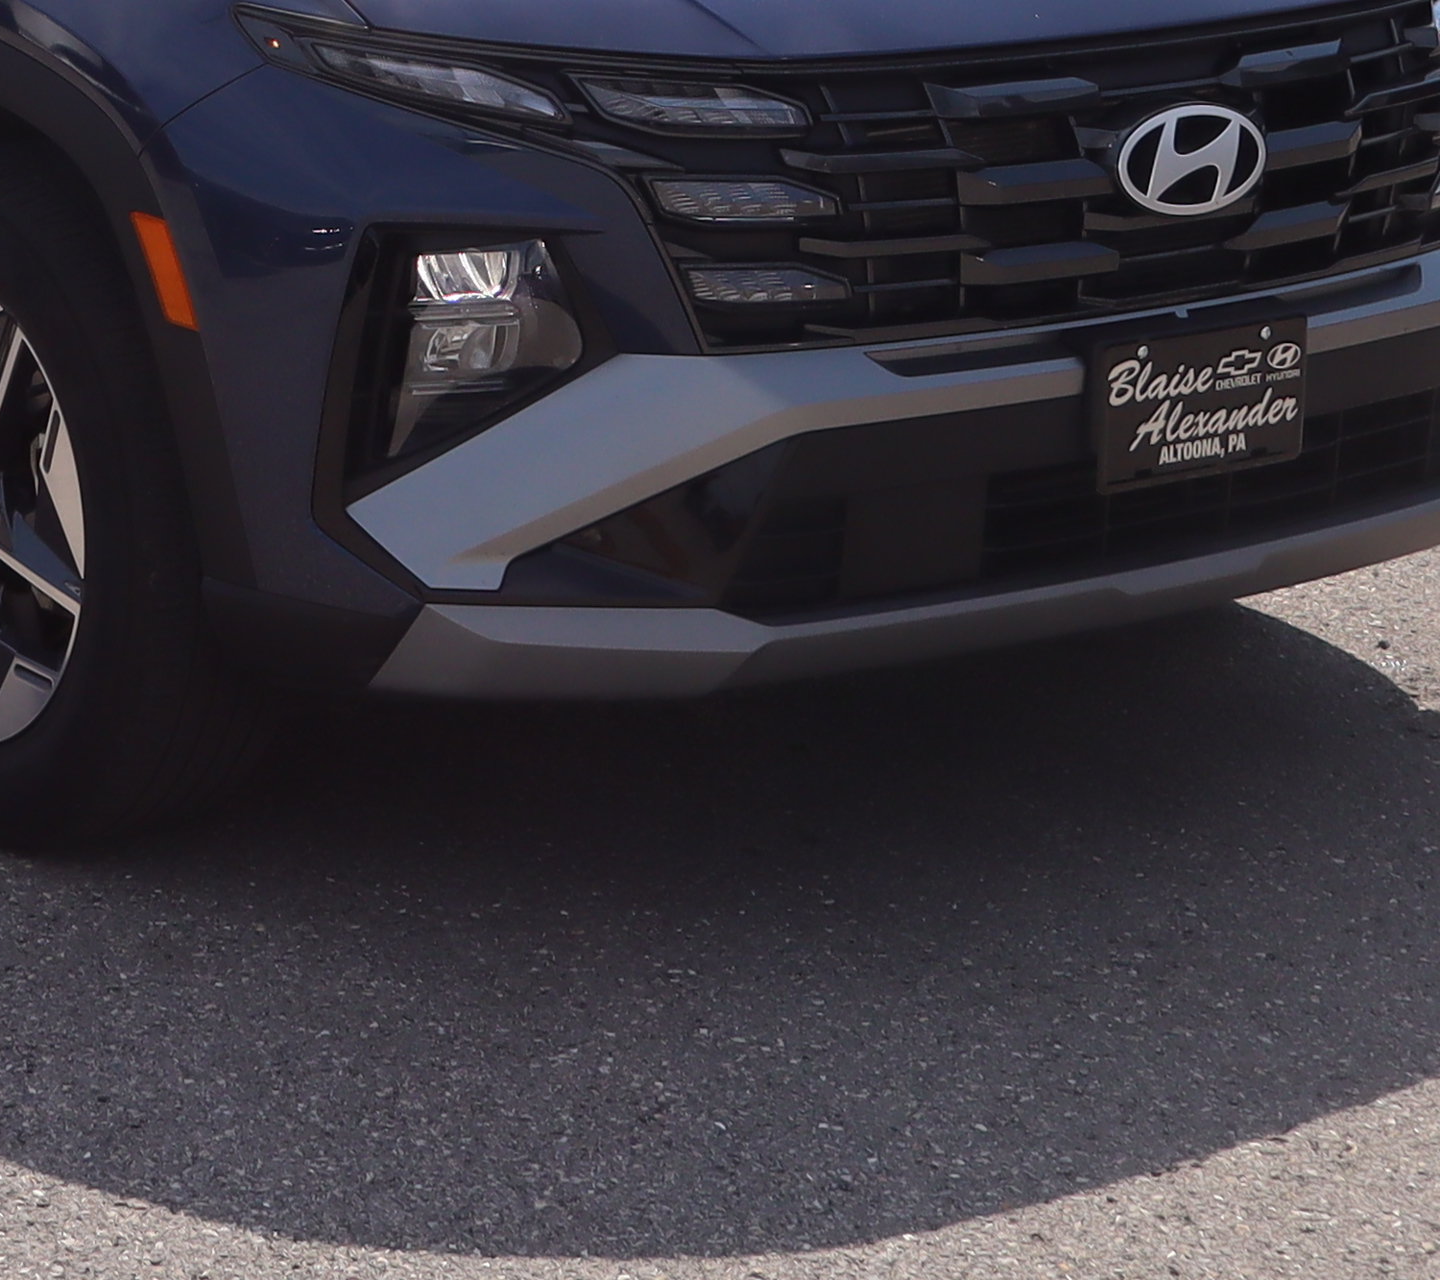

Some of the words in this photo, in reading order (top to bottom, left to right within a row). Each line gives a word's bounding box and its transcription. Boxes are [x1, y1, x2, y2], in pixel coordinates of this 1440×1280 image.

[1108, 358, 1216, 407] Blaise
[1215, 373, 1263, 391] CHEVROLET
[1265, 368, 1301, 383] HYUNDAI
[1128, 386, 1299, 453] Alexander
[1158, 434, 1226, 465] ALTOONA,
[1227, 432, 1247, 454] PA
